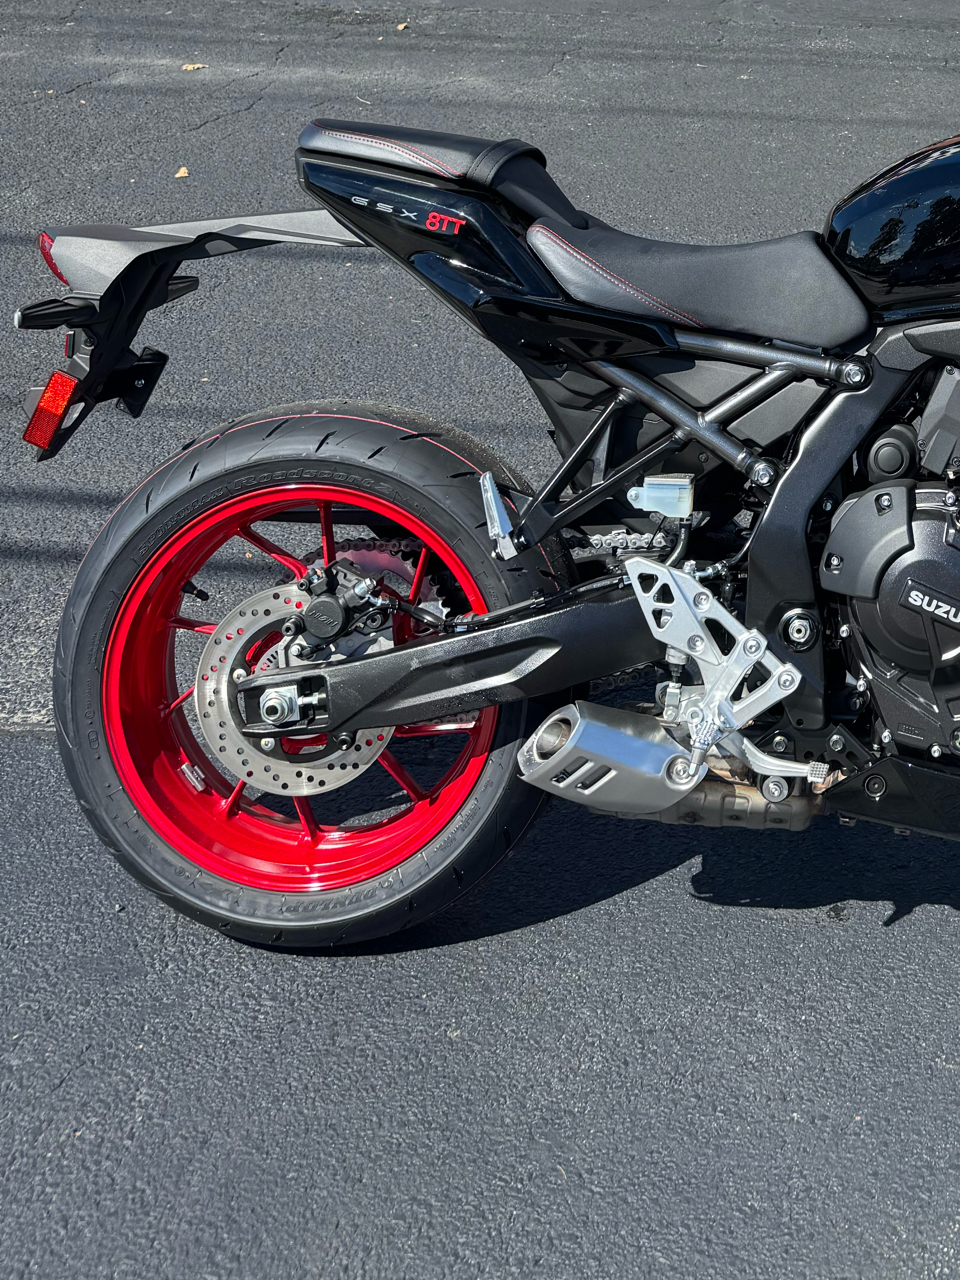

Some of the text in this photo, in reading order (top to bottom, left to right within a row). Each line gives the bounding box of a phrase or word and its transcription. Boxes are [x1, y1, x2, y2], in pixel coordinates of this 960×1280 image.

[350, 195, 467, 236] GSX 8TT
[233, 467, 375, 490] Roadsport
[281, 884, 378, 915] DUNLOP
